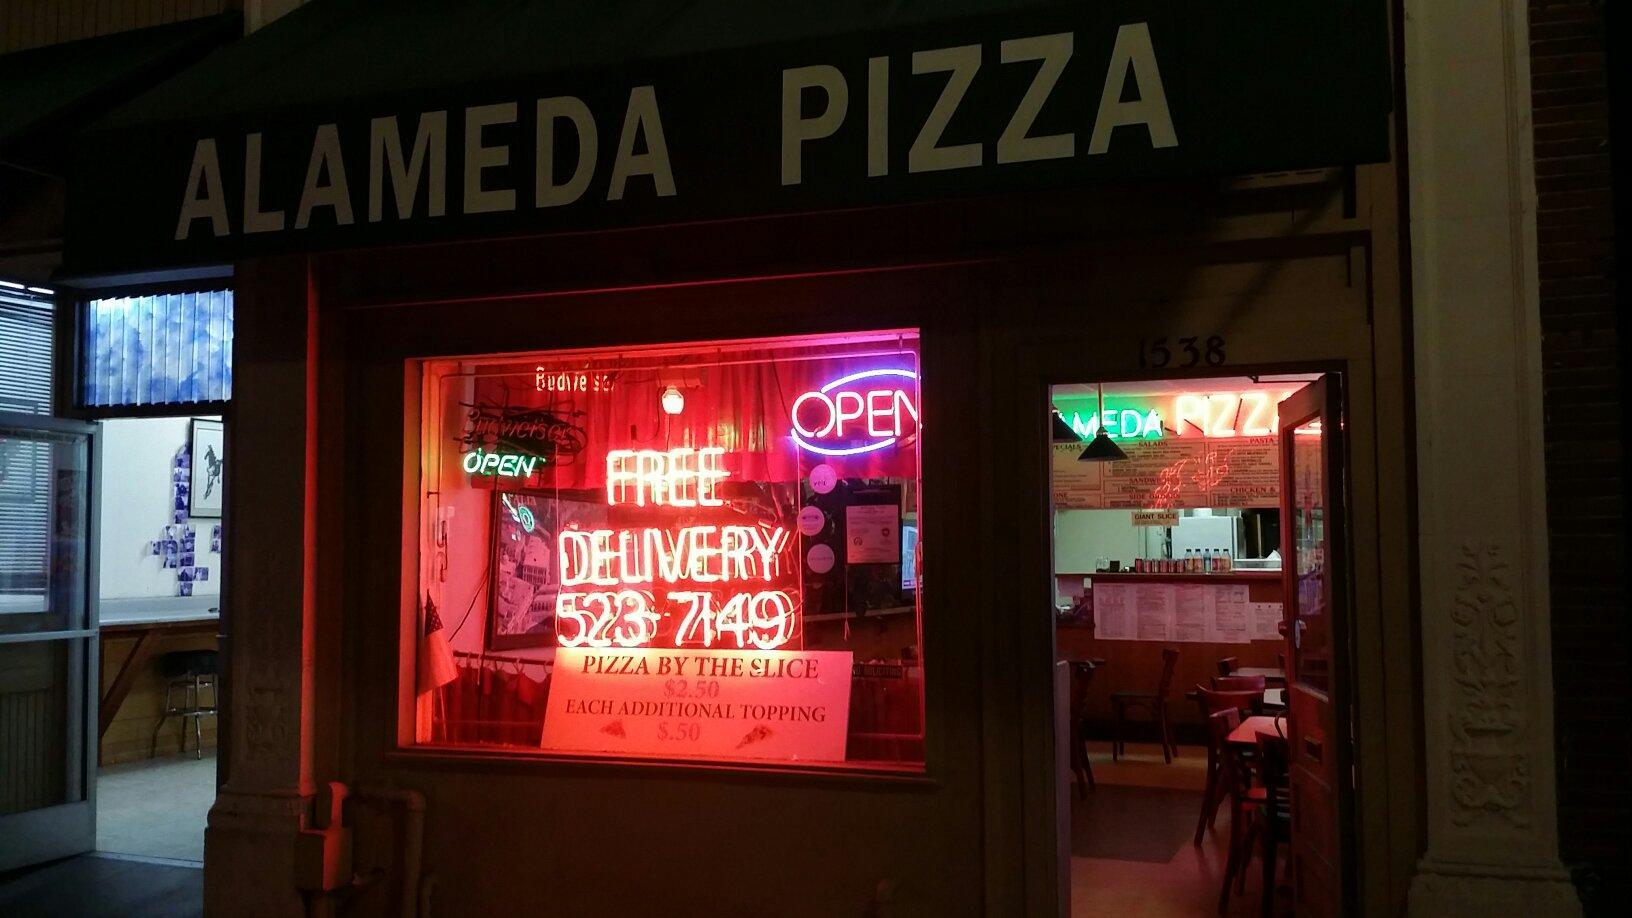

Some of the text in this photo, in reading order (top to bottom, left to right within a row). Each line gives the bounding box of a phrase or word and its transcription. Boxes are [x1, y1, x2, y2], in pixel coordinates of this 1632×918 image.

[174, 22, 1179, 240] ALAMEDA PIZZA
[1139, 335, 1226, 368] 1538
[791, 389, 921, 437] OPEN
[463, 451, 537, 478] OPEN
[606, 448, 731, 506] FREE
[559, 526, 784, 587] DELIVERY
[581, 655, 819, 679] PIZZA BY THE SLICE
[664, 679, 720, 699] $2.50
[565, 699, 826, 723] EACH ADDITIONAL TOPPING
[657, 722, 701, 742] $.50
